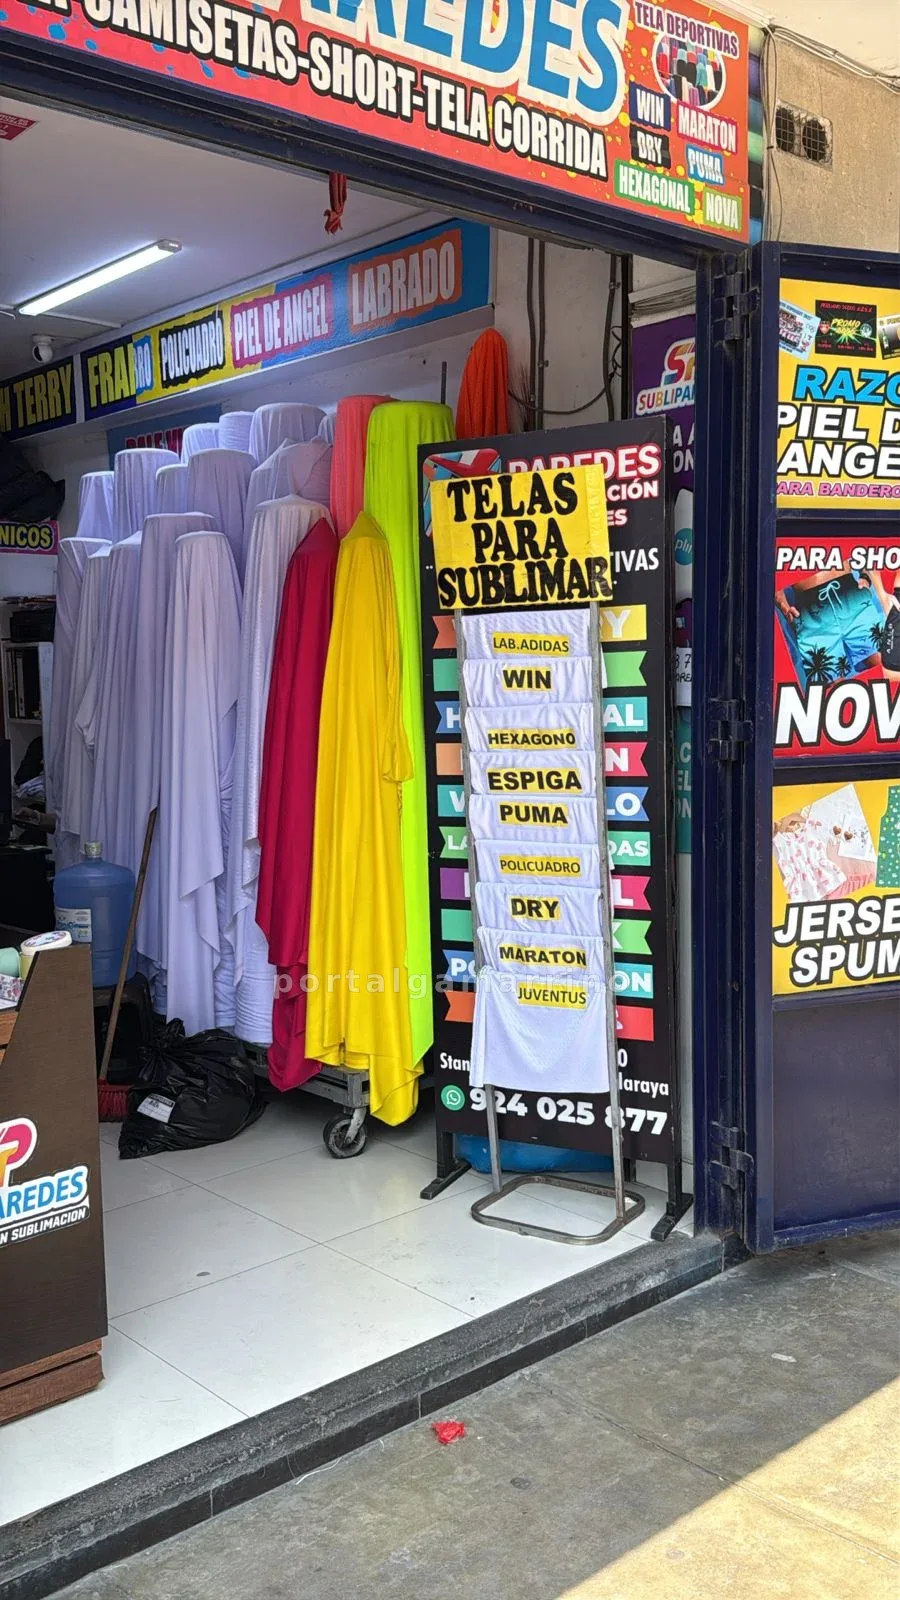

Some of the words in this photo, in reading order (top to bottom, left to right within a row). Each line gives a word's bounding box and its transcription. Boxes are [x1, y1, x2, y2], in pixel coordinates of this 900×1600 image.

[635, 2, 664, 31] TELA
[667, 12, 738, 57] DEPORTIVAS
[636, 88, 664, 127] WIN
[494, 101, 608, 177] CORRIDA
[637, 130, 662, 164] DRY
[678, 105, 737, 153] MARATON
[687, 147, 724, 184] PUMA
[619, 164, 690, 213] HEXAGONAL
[705, 191, 739, 229] NOVA
[352, 241, 455, 325] LABRADO
[233, 307, 262, 361] PIEL
[263, 301, 281, 351] DE
[284, 284, 328, 346] ANGEL
[161, 317, 224, 381] POLICUADRO
[13, 363, 73, 428] TERRY
[777, 404, 867, 440] PIEL
[776, 441, 900, 477] ANGE
[447, 472, 578, 523] TELAS
[471, 517, 569, 564] PARA
[776, 547, 843, 570] PARA
[437, 556, 613, 607] SUBLIMAR
[493, 637, 569, 653] LAB.ADIDAS
[502, 669, 552, 689] WIN
[488, 732, 576, 745] HEXAGONO
[487, 770, 582, 791] ESPIGA
[500, 804, 568, 824] PUMA
[500, 859, 581, 874] POLICUADRO
[511, 897, 560, 918] DRY
[499, 946, 587, 966] MARATON
[517, 987, 587, 1005] JUVENTUS
[469, 1087, 528, 1117] 924
[536, 1096, 595, 1126] 025
[604, 1105, 668, 1136] 877
[11, 1207, 86, 1240] SUBLIMACION
